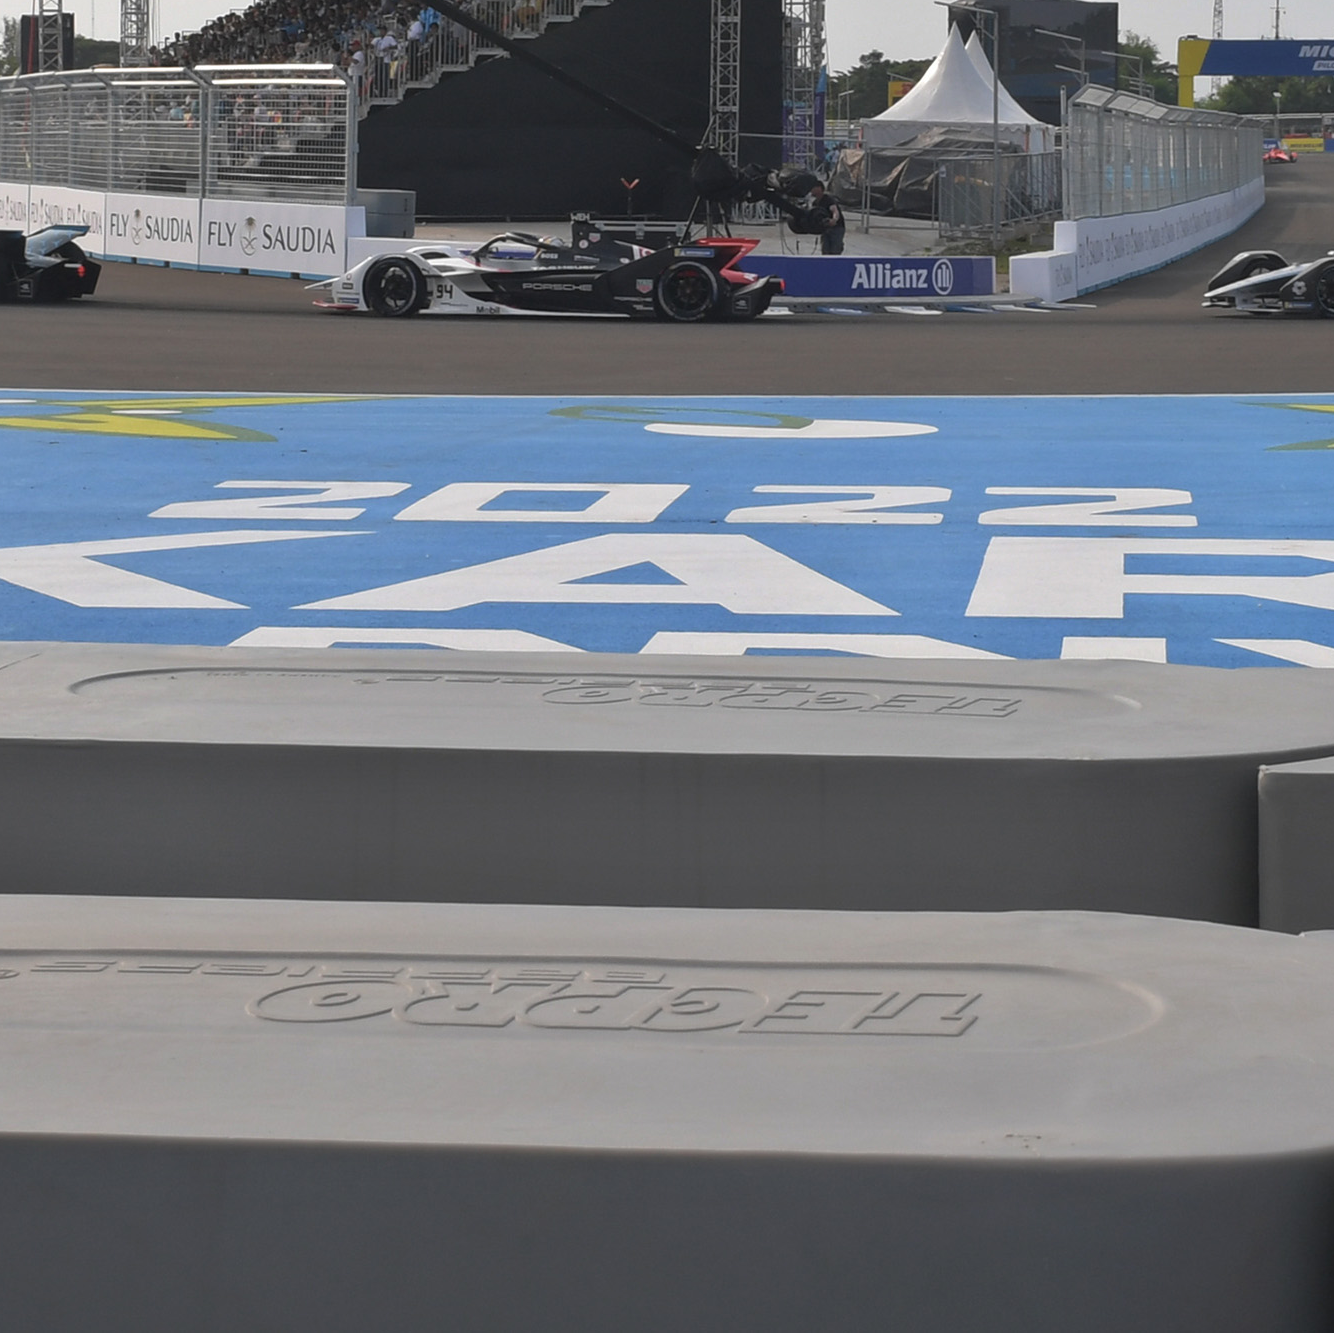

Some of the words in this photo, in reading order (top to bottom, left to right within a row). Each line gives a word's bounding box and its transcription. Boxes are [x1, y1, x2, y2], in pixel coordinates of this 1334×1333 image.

[110, 213, 130, 238] FLY
[145, 215, 193, 243] SAUDIA
[208, 221, 237, 248] FLY
[262, 224, 336, 255] SAUDIA
[522, 282, 593, 292] PORSCHE
[851, 263, 928, 289] Allianz
[436, 284, 453, 299] 94
[147, 480, 1198, 528] 2022
[244, 979, 979, 1037] TECPRO
